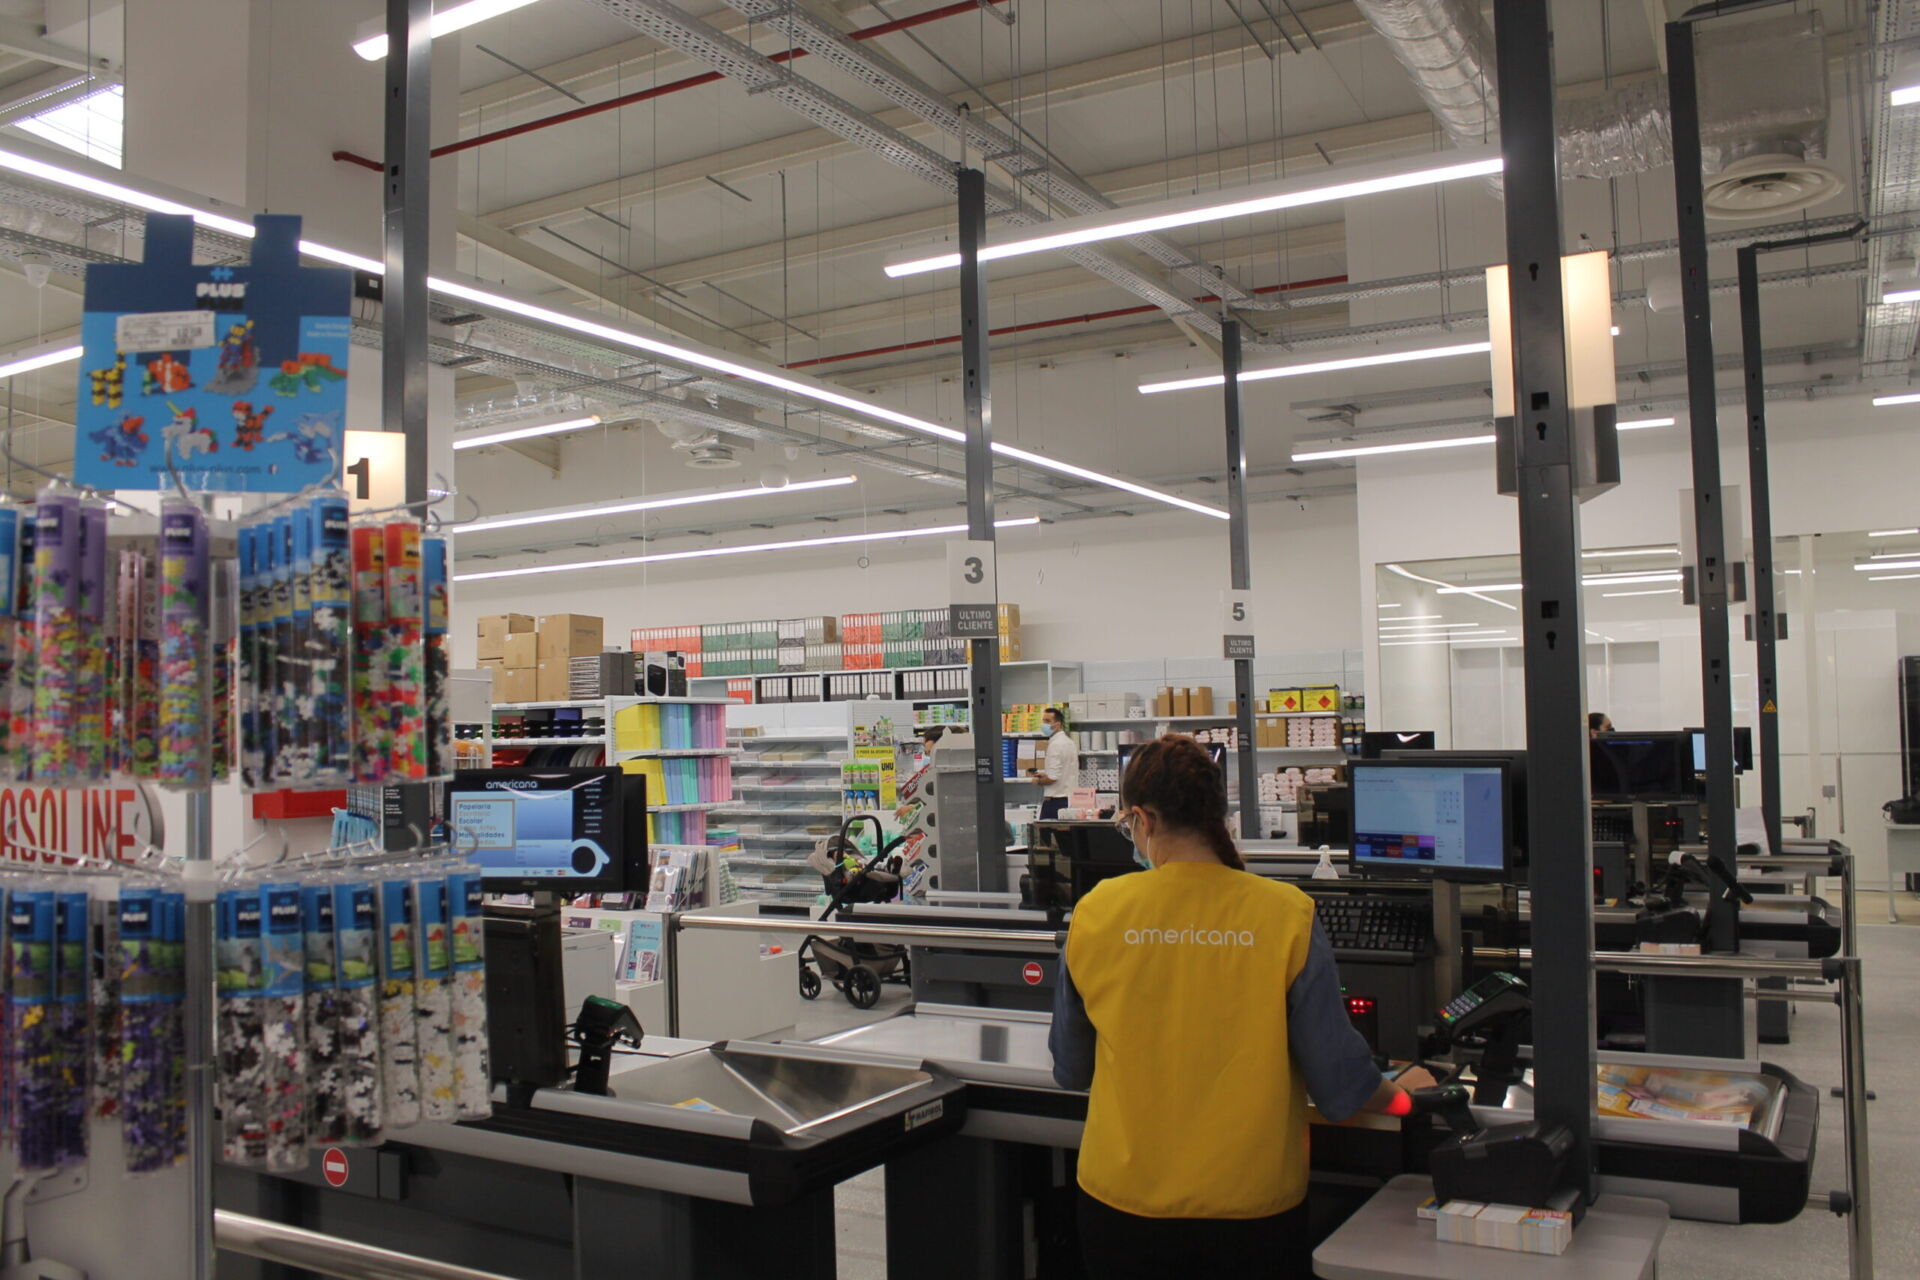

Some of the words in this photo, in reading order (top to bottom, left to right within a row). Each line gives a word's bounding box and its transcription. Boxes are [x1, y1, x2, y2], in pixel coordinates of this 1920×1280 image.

[196, 282, 246, 297] PLUS
[347, 457, 369, 500] 1
[964, 556, 984, 584] 3
[1232, 602, 1246, 622] 5
[957, 620, 994, 631] CLIENTE
[881, 762, 894, 771] UHU
[485, 780, 538, 789] americana
[458, 803, 491, 811] Papelaria
[458, 817, 483, 825] Escolar
[1124, 924, 1254, 946] americana
